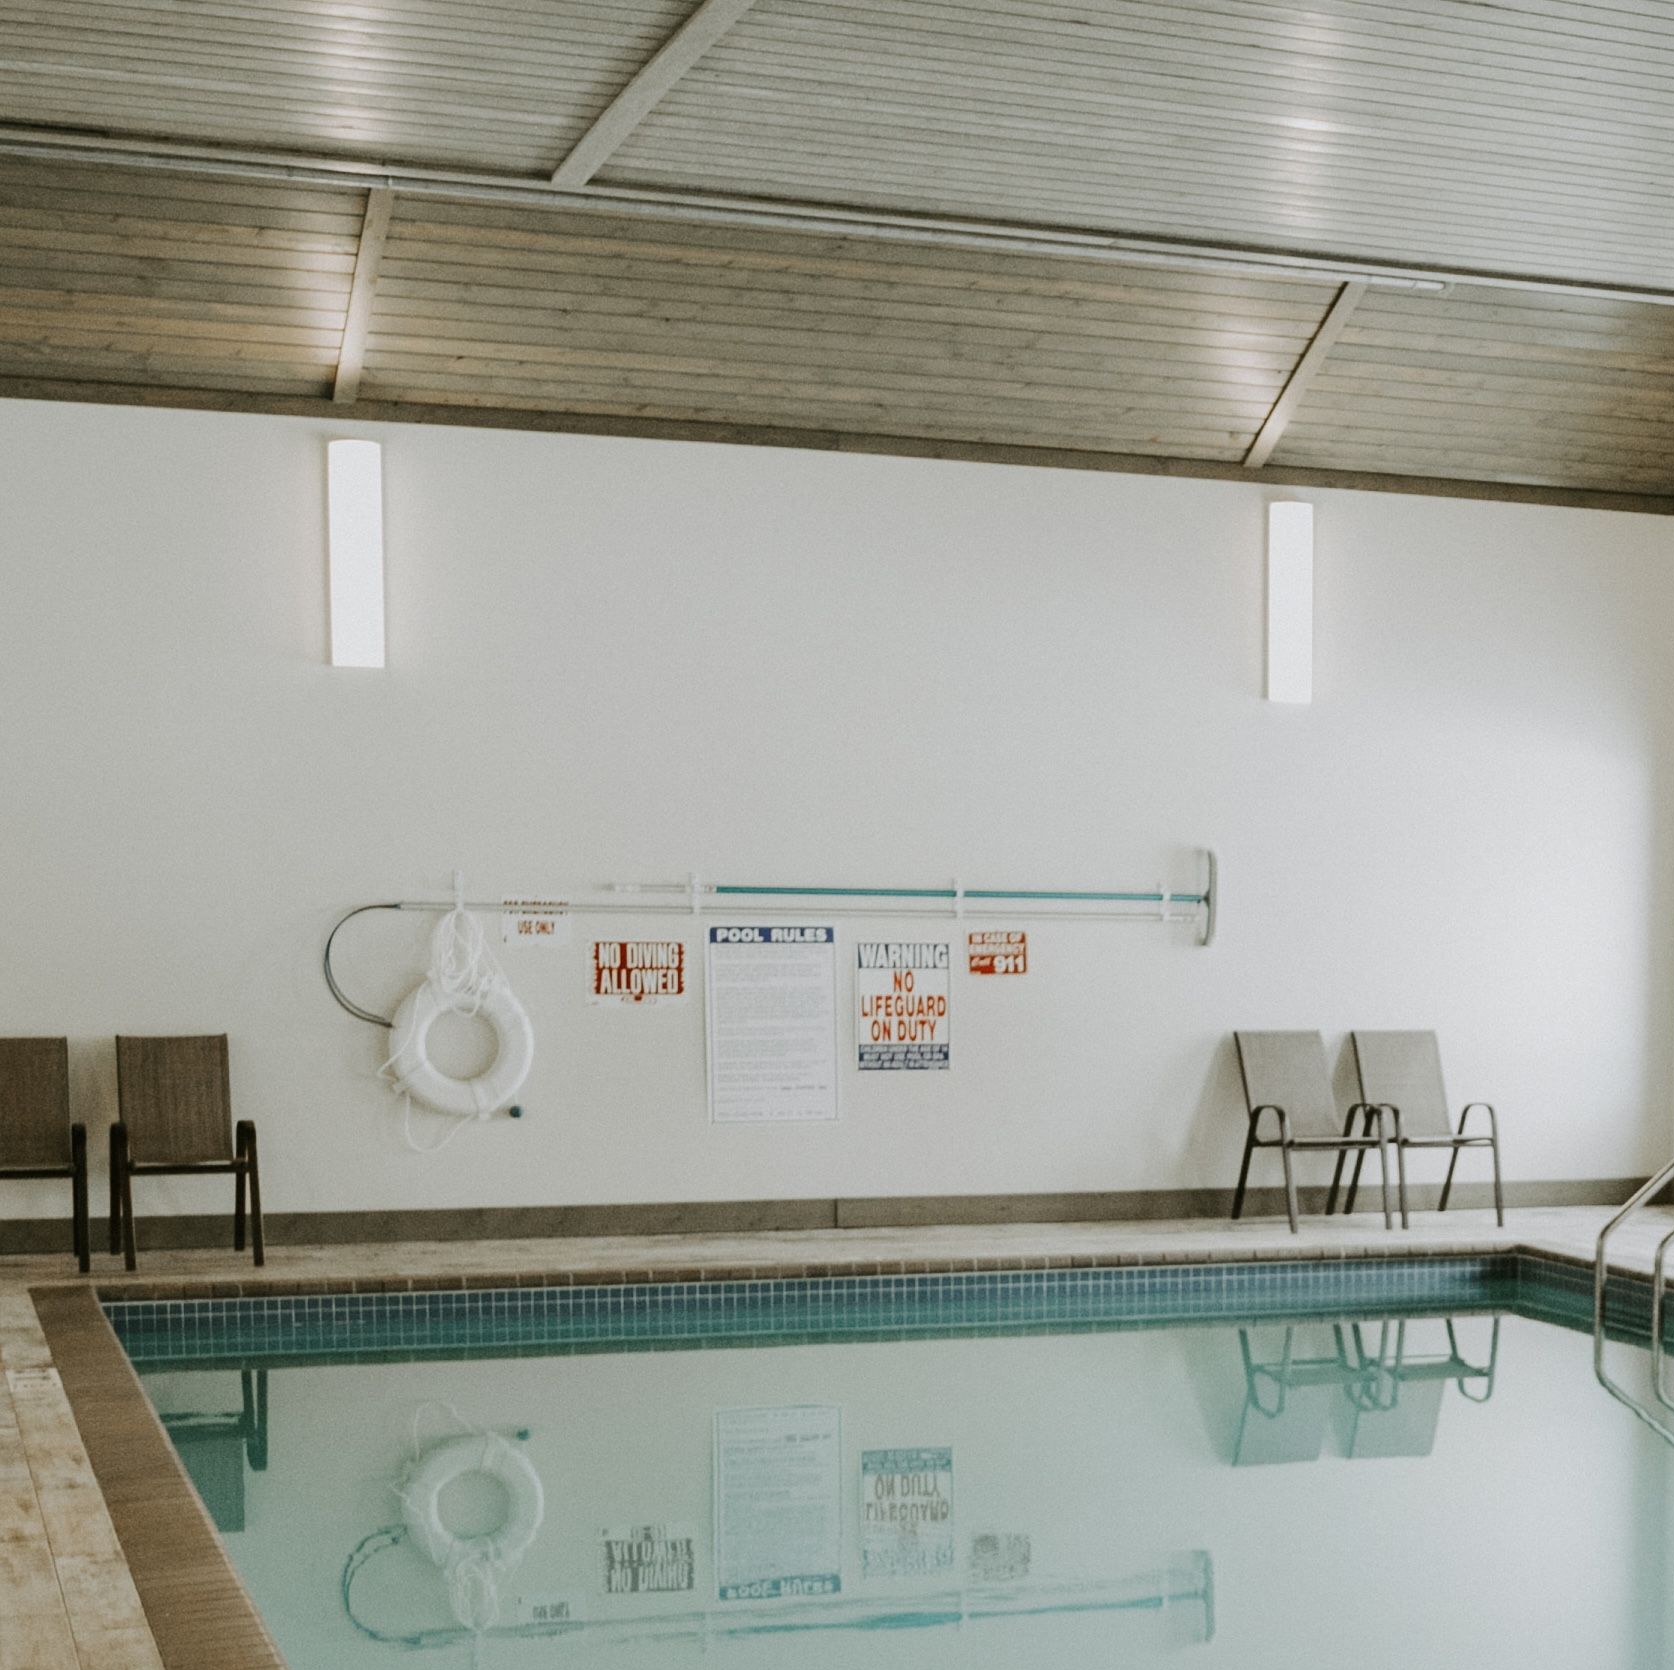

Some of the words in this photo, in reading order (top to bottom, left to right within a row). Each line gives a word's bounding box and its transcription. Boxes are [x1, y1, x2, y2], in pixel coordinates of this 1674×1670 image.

[716, 928, 764, 942] POOL
[770, 928, 828, 942] RULES
[600, 943, 621, 968] NO
[626, 943, 680, 968] DIVING
[860, 944, 948, 968] WARNING
[994, 955, 1025, 973] 911
[601, 969, 679, 994] ALLOWED
[893, 970, 914, 992] NO
[861, 996, 947, 1017] LIFEGUARD
[871, 1020, 892, 1041] ON
[898, 1020, 936, 1041] DUTY
